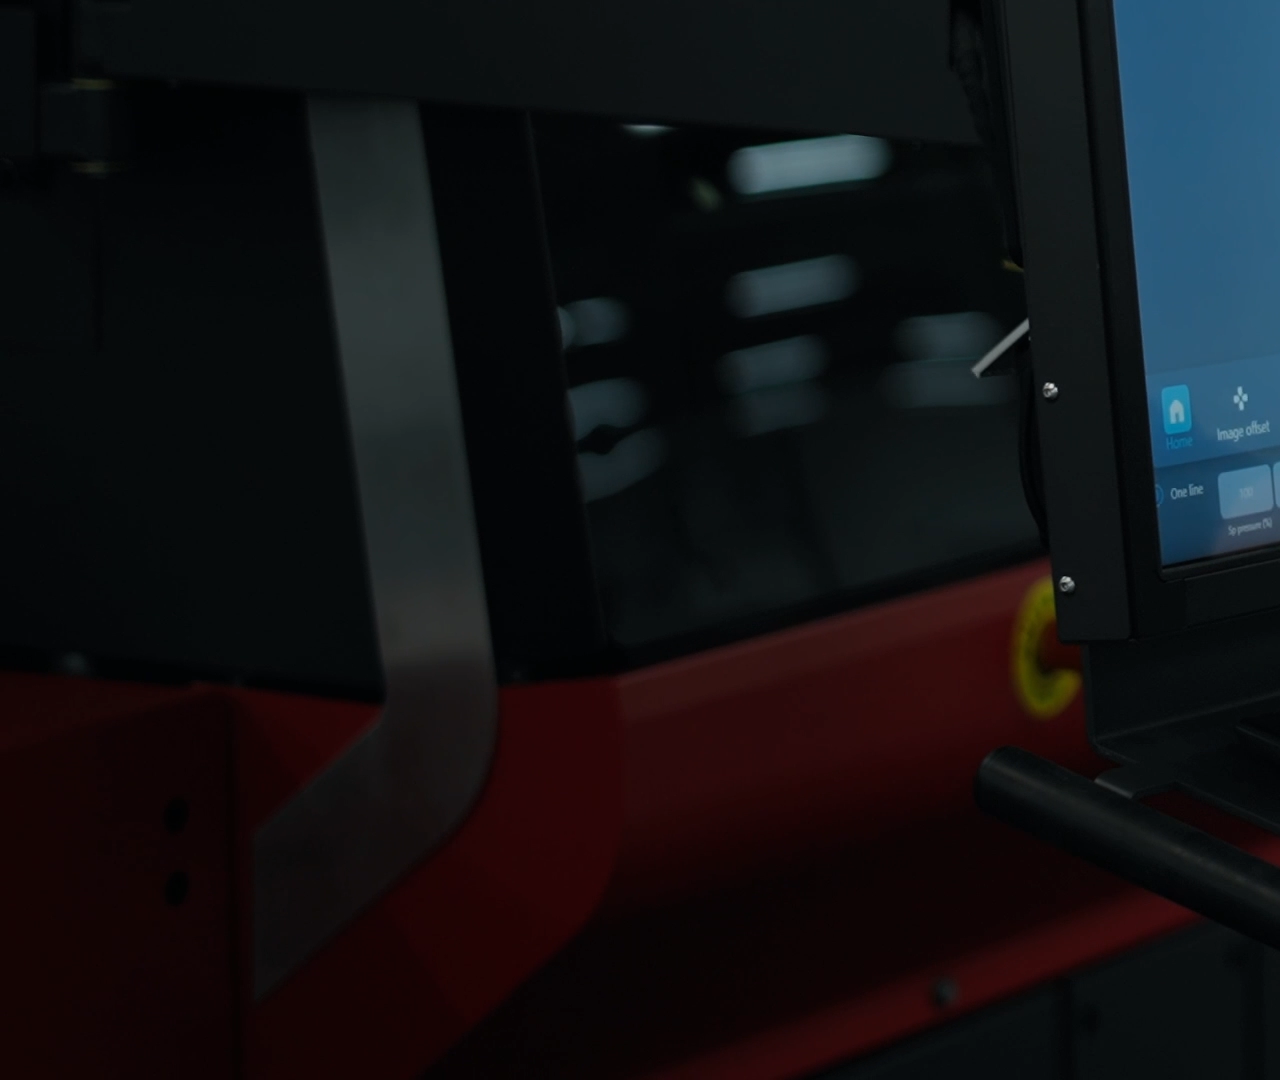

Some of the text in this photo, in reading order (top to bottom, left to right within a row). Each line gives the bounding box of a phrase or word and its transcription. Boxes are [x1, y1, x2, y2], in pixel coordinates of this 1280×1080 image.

[1217, 420, 1271, 442] Image offset
[1166, 436, 1193, 450] Home
[1170, 483, 1204, 500] One line
